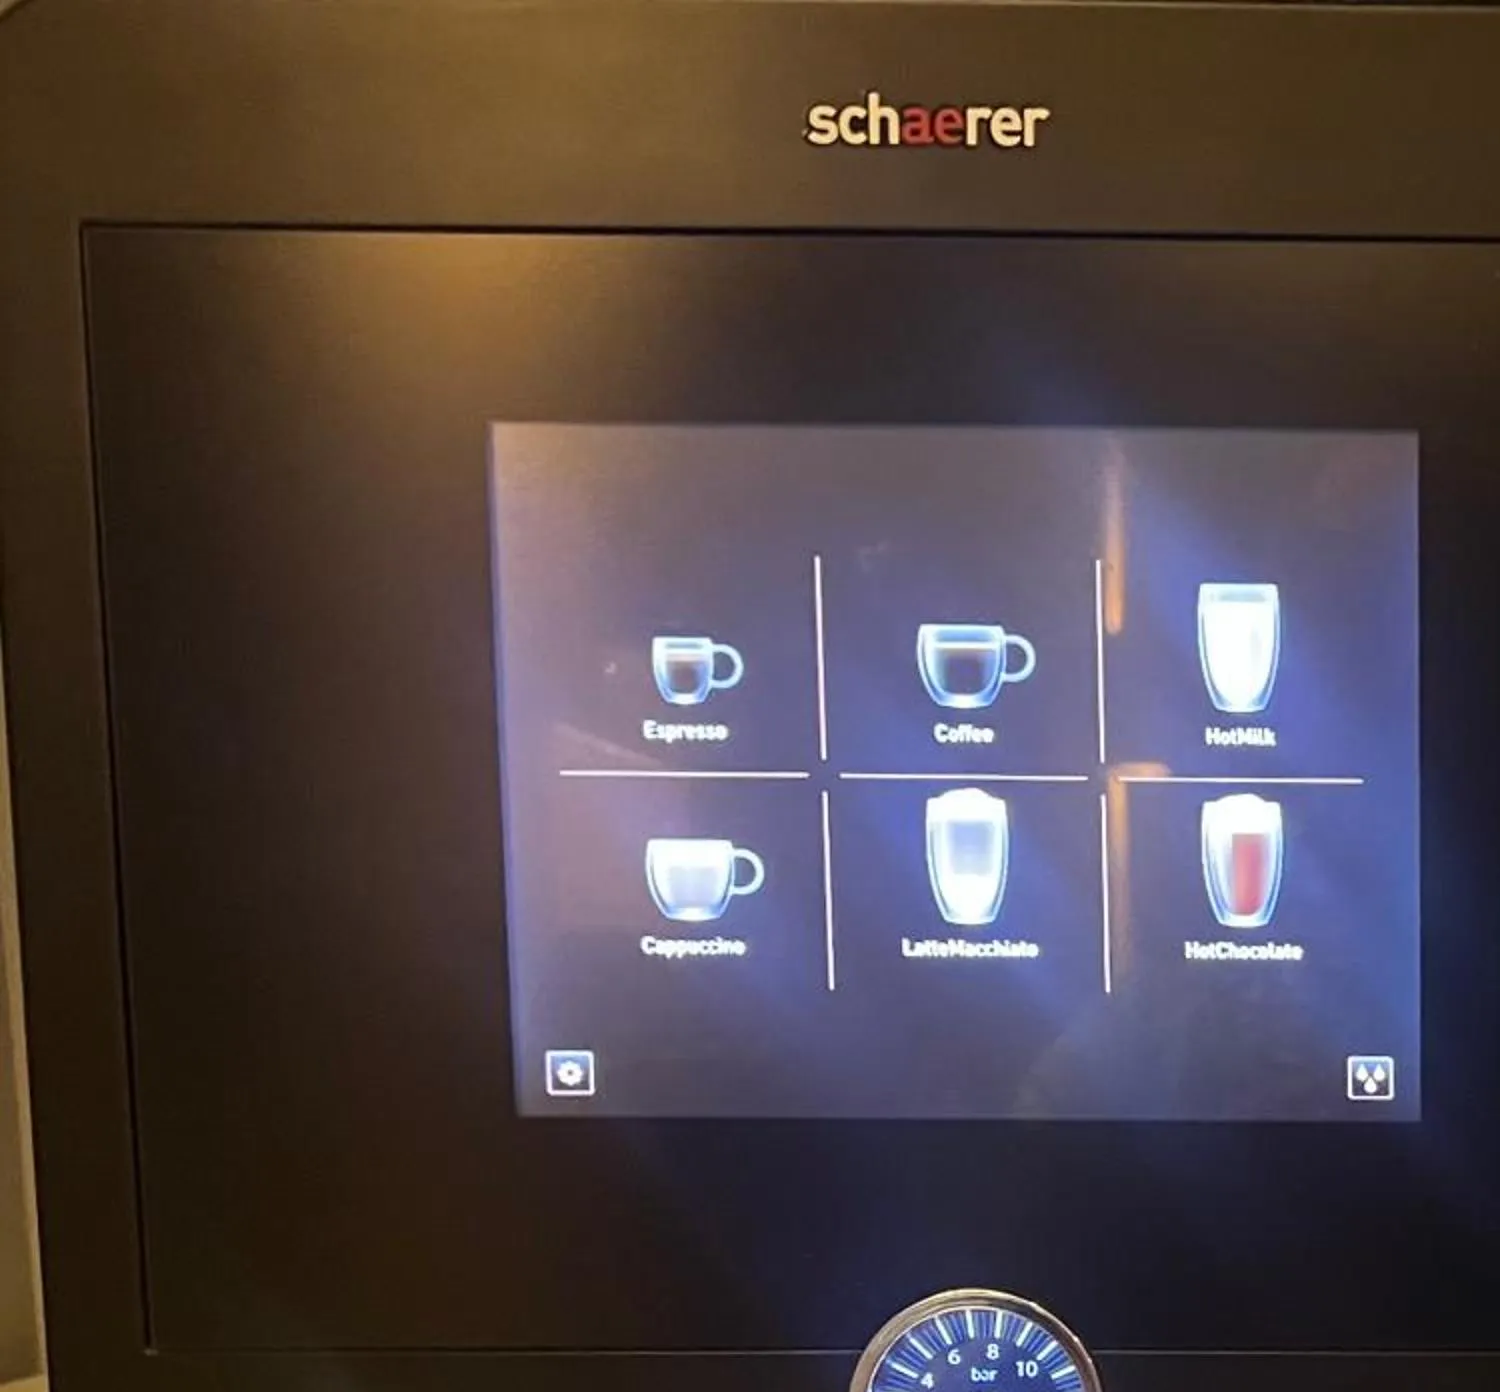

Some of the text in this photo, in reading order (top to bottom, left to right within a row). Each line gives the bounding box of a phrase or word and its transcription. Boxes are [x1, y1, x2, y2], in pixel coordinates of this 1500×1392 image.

[807, 92, 1050, 147] schaerer
[643, 720, 729, 743] Espresso
[934, 723, 995, 742] Coffee
[1205, 728, 1277, 747] HotMilk
[1184, 941, 1304, 960] HotChocolate
[948, 1349, 961, 1365] 6
[987, 1344, 1000, 1360] 8
[970, 1367, 998, 1382] bar
[1016, 1361, 1039, 1378] 10
[921, 1373, 934, 1389] 4
